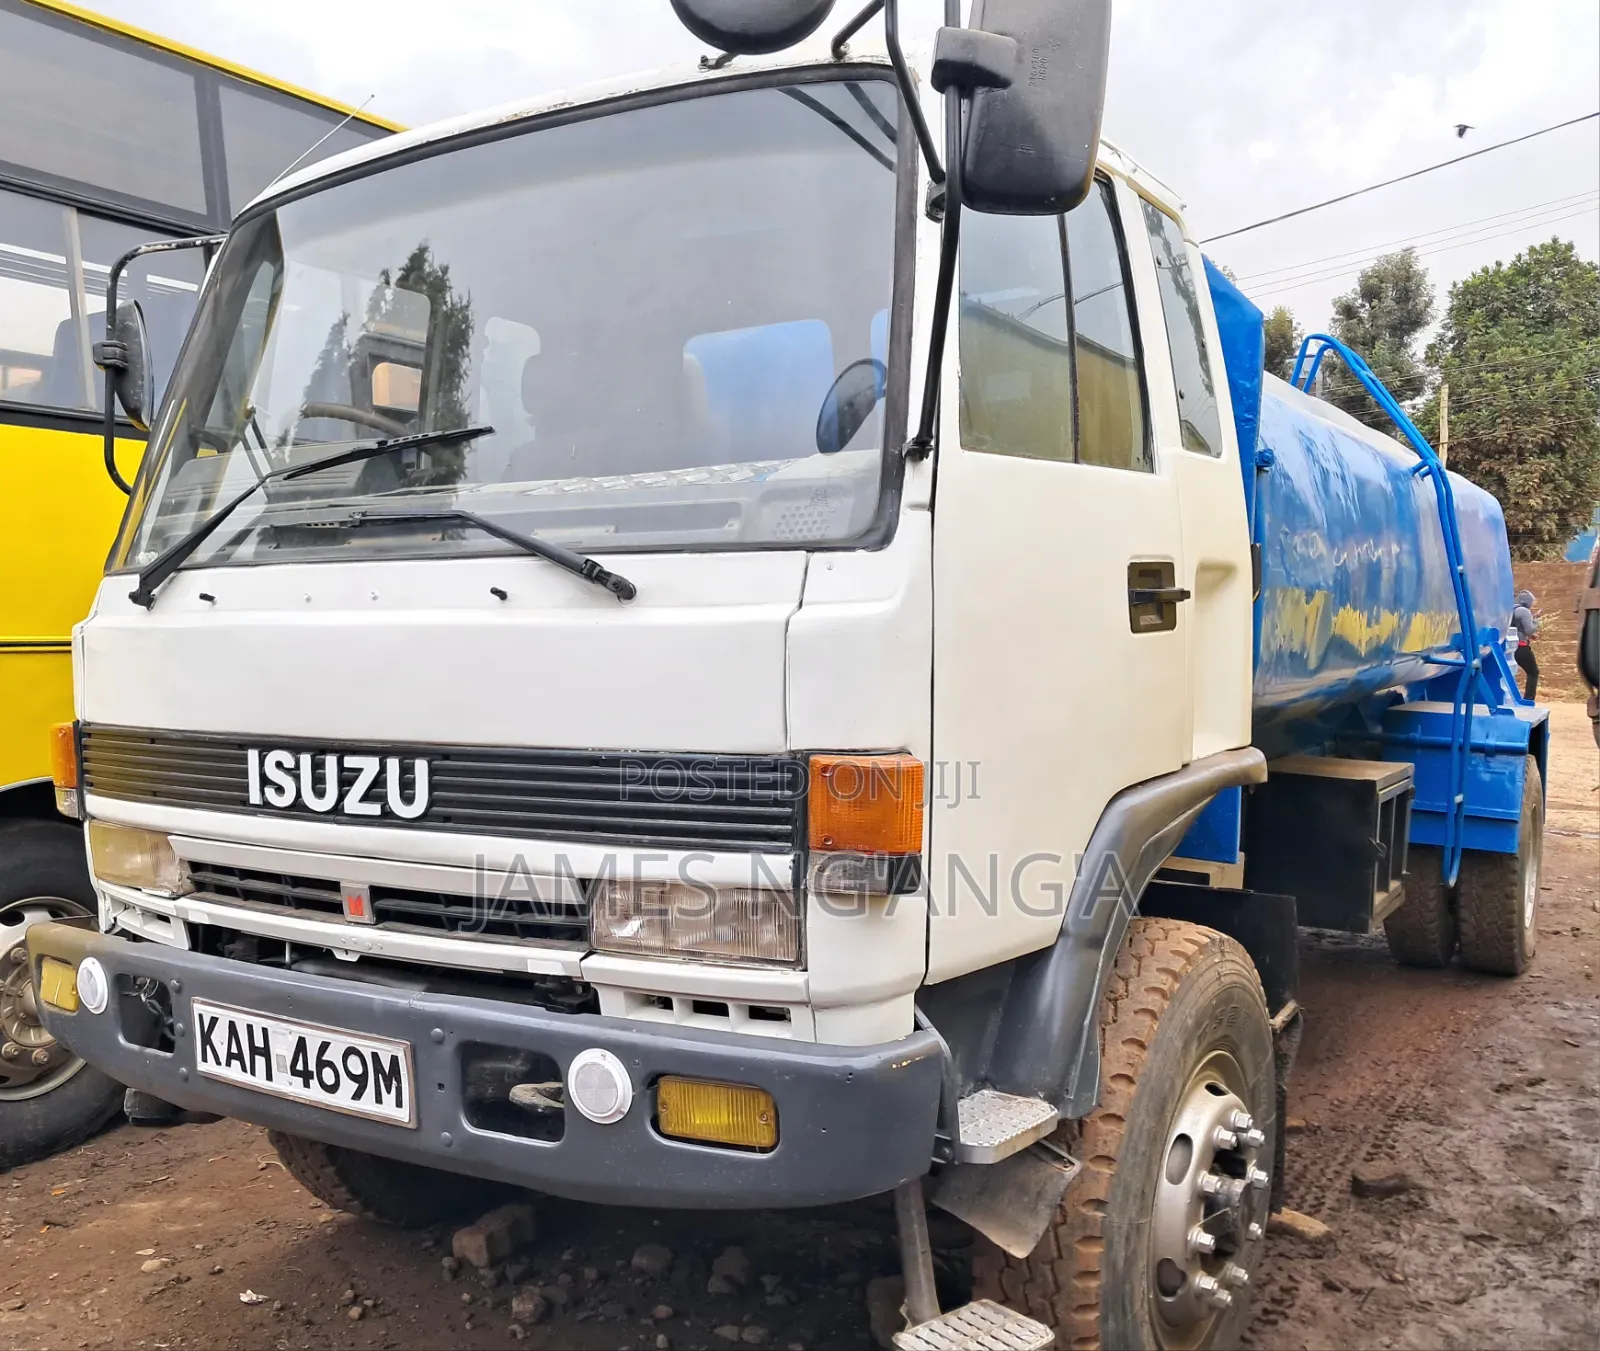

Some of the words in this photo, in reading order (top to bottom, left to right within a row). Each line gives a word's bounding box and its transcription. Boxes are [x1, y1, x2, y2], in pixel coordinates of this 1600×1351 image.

[247, 748, 429, 819] ISUZU
[198, 1012, 273, 1082] KAH
[289, 1035, 404, 1109] 469M
